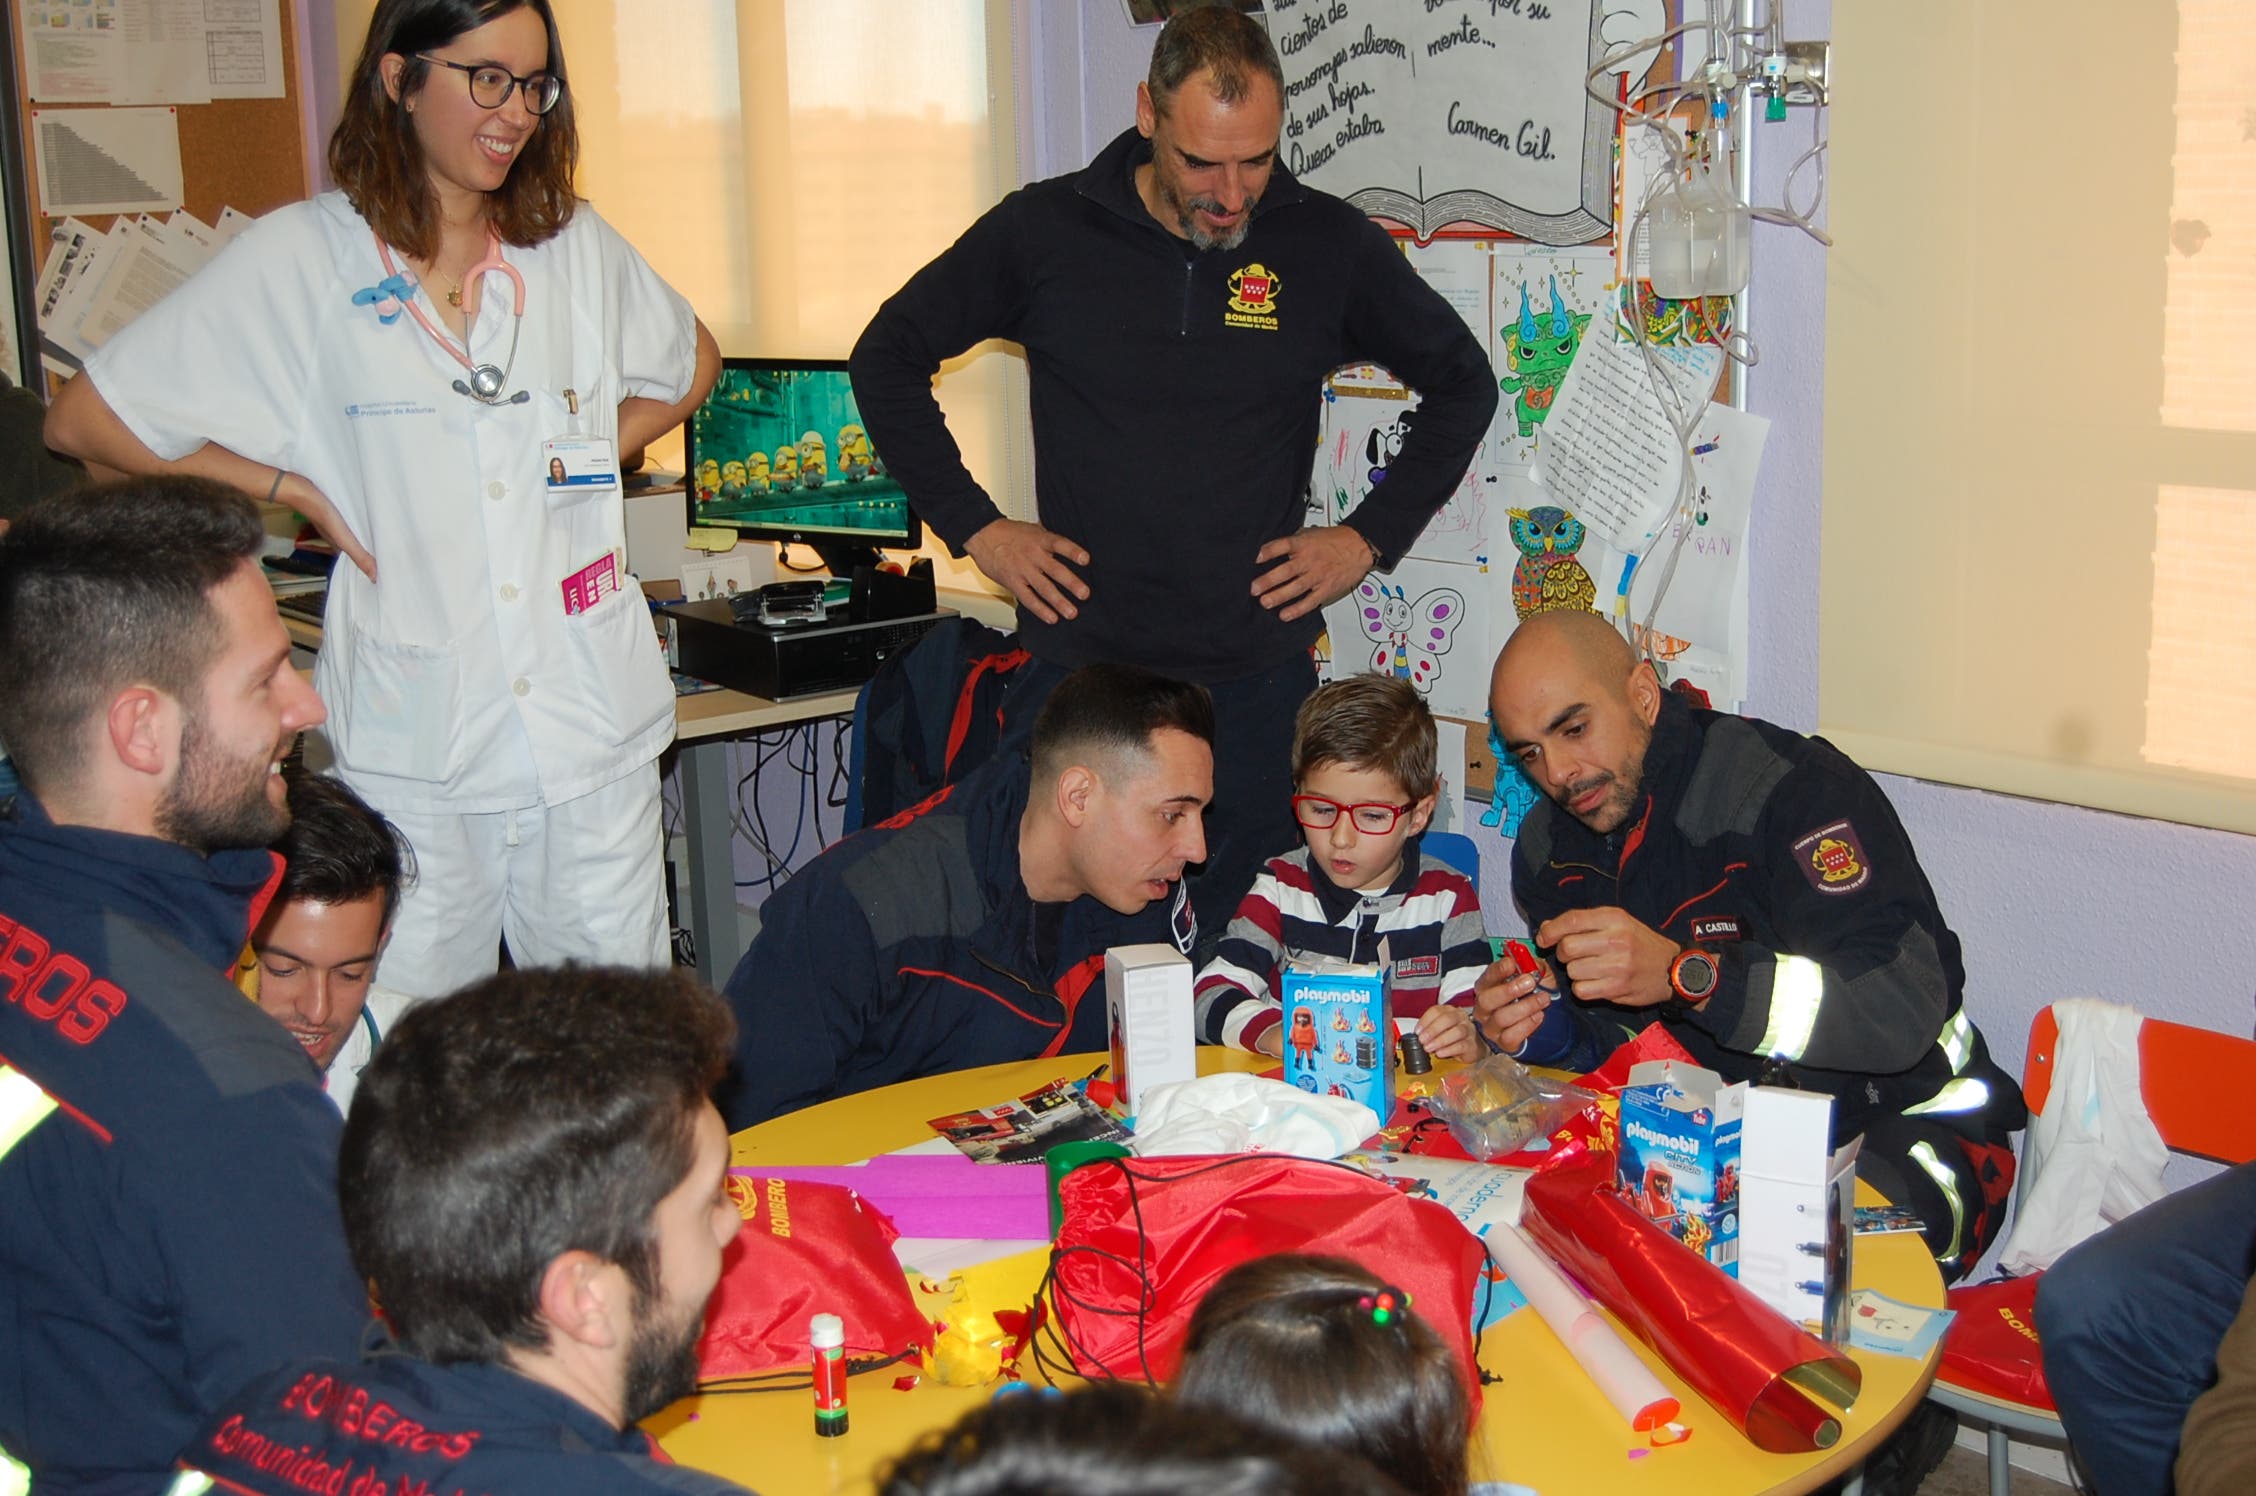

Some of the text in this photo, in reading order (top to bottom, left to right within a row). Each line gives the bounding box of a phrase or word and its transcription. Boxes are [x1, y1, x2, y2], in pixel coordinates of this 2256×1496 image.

[1281, 0, 1348, 55] cientos de
[1526, 3, 1551, 19] su
[1285, 24, 1406, 110] personajes salieron
[1286, 82, 1375, 138] de sus hojas.
[1335, 113, 1385, 147] estaba
[1447, 100, 1555, 161] Carmen Gil.
[1225, 312, 1279, 325] BOMBEROS
[1695, 921, 1738, 935] A CASTILLO
[1294, 986, 1371, 1004] playmobil
[1626, 1120, 1700, 1156] playmobil
[281, 1372, 482, 1461] BOMBEROS
[210, 1413, 354, 1496] Comunidad
